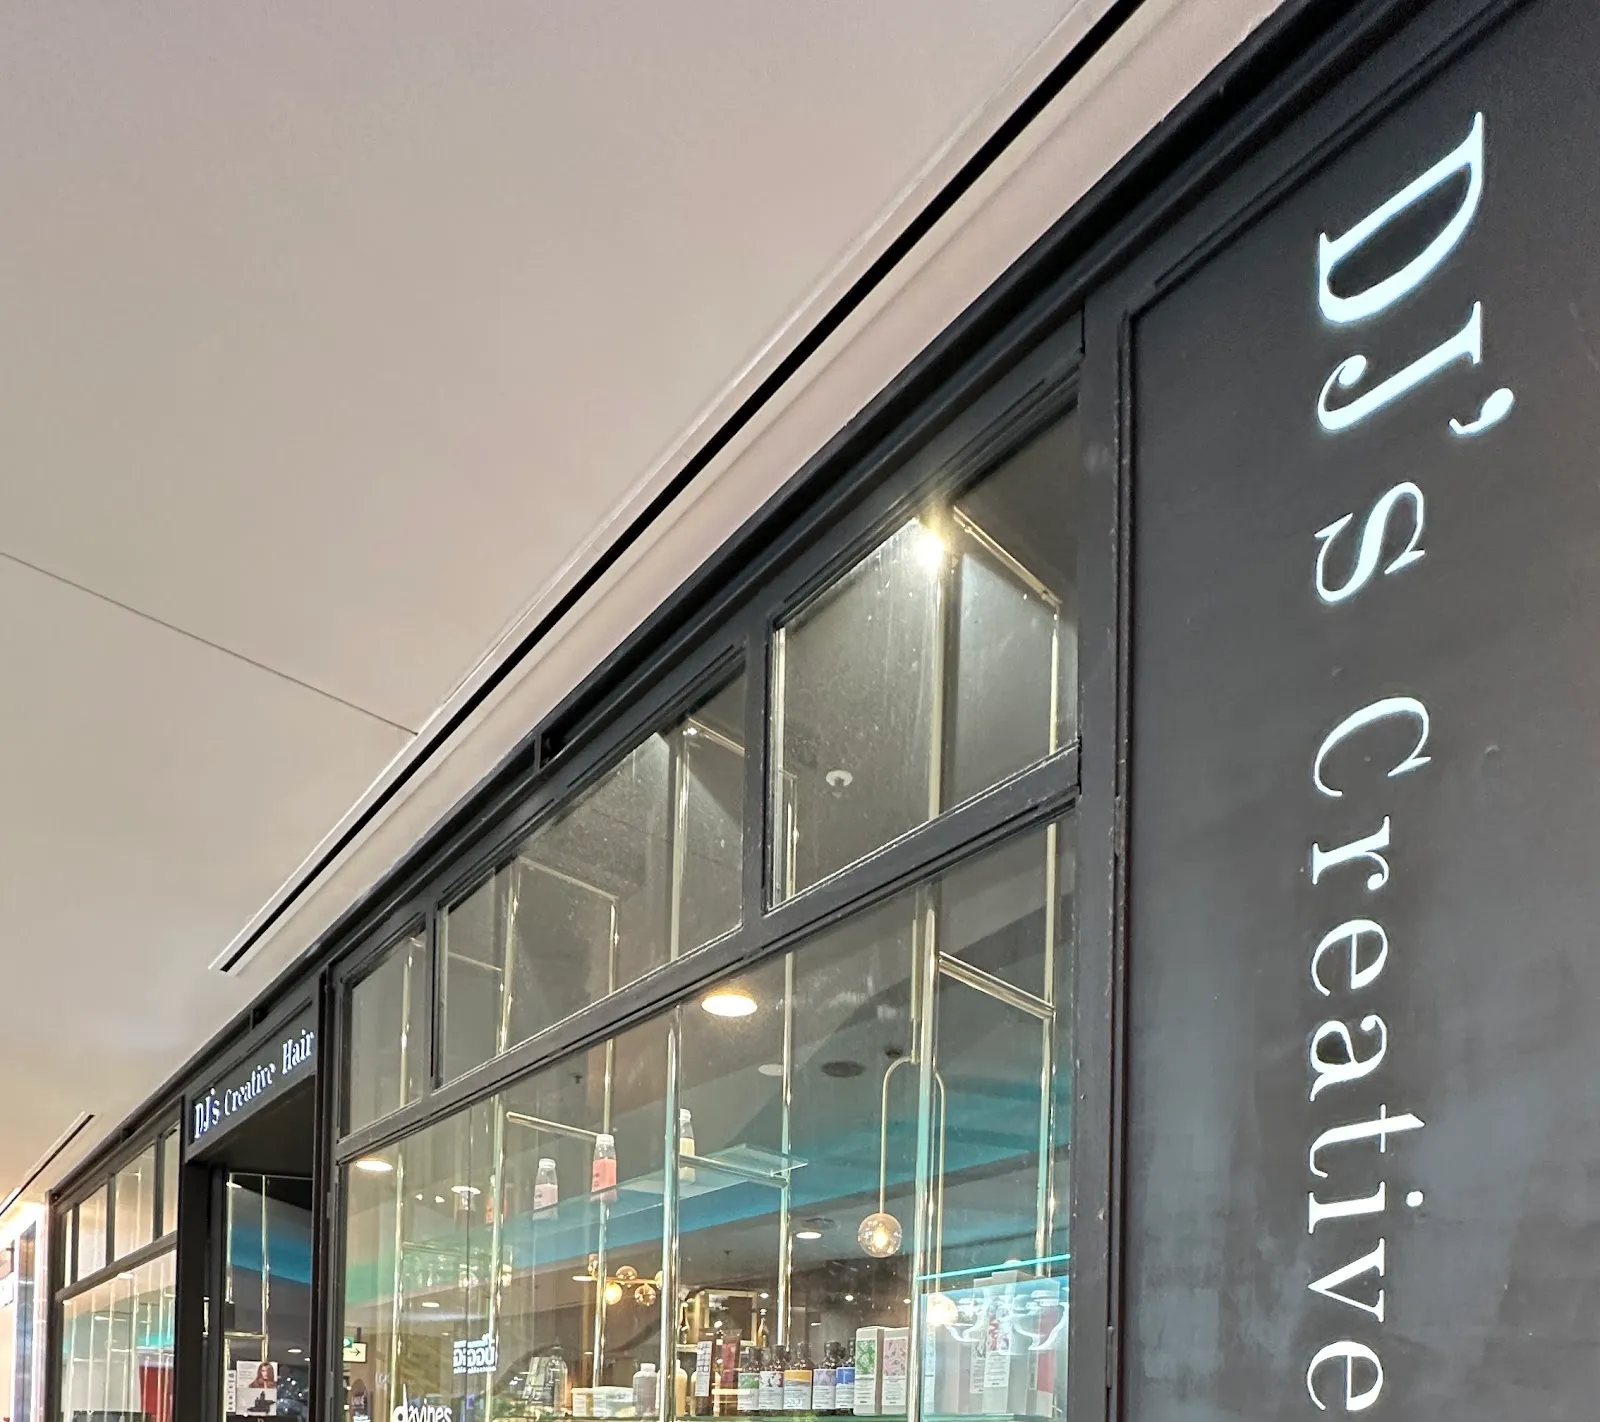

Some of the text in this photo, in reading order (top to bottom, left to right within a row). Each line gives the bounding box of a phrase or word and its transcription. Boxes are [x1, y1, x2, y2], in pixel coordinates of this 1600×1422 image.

[1314, 111, 1515, 602] DJ's
[194, 1029, 315, 1139] DJ's Creative Hair
[1307, 697, 1431, 1411] Creative
